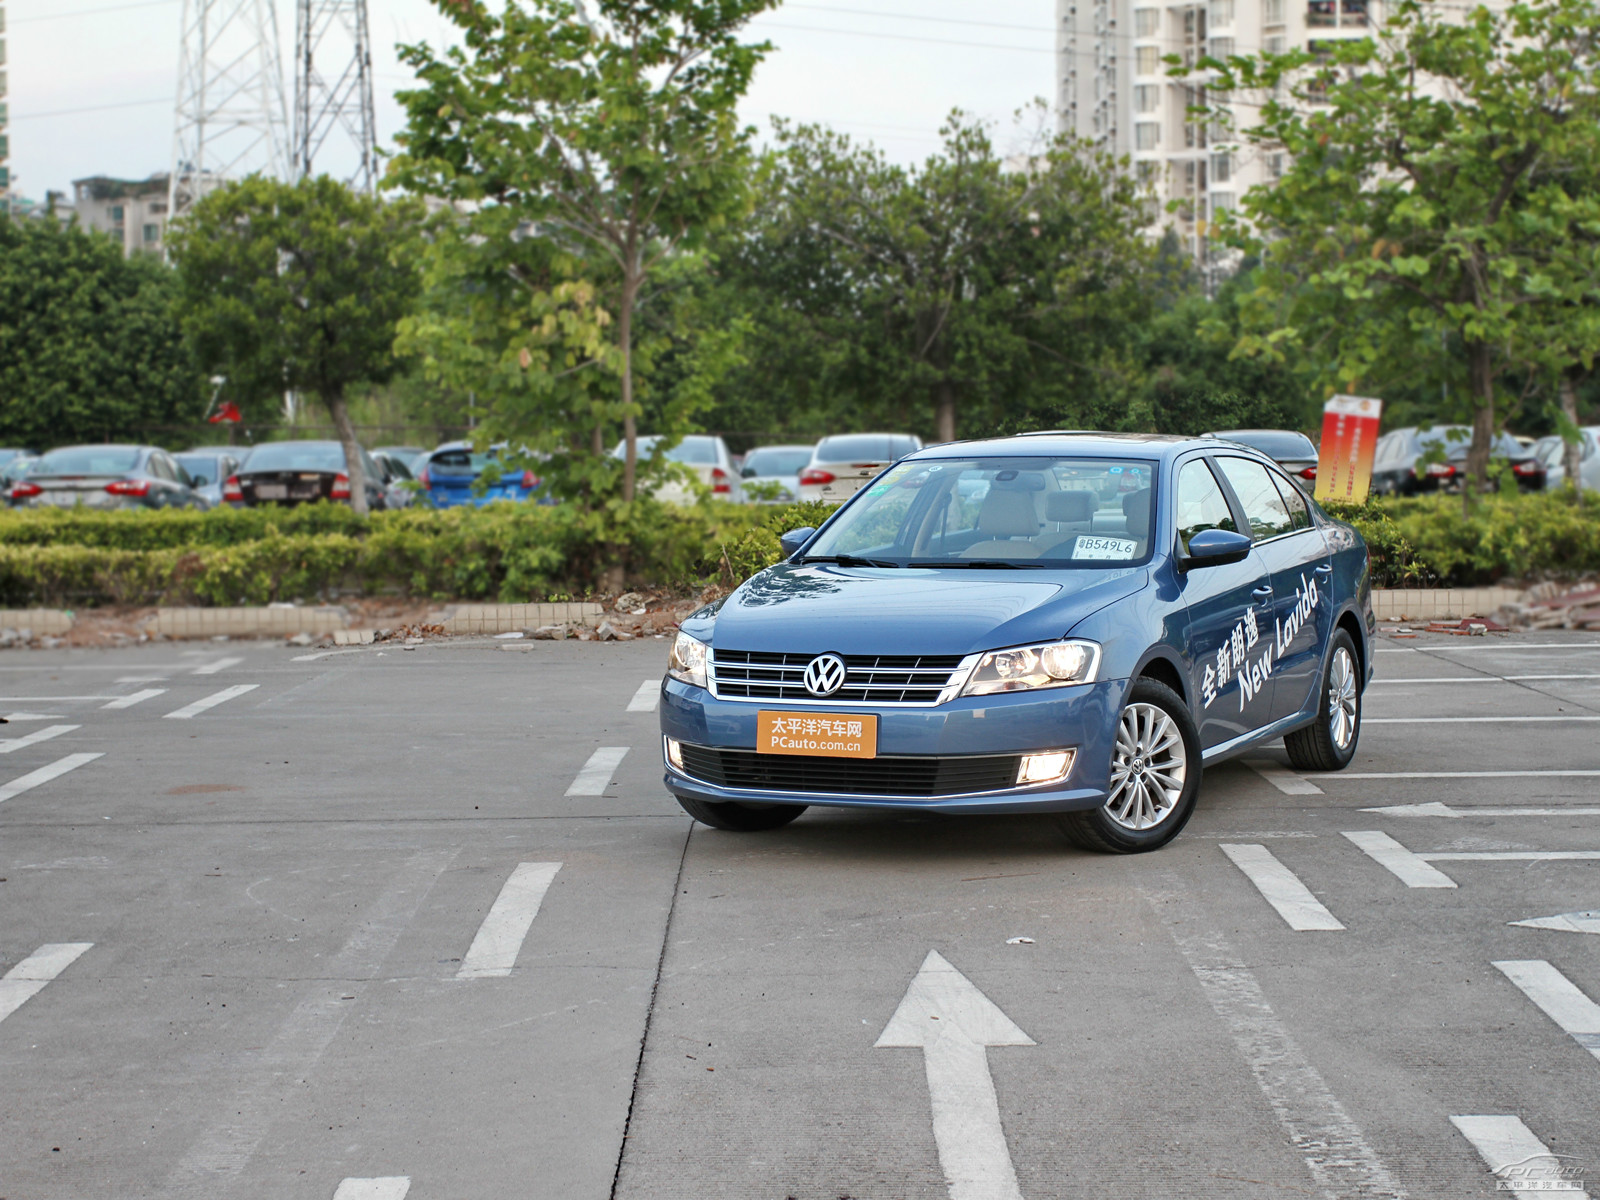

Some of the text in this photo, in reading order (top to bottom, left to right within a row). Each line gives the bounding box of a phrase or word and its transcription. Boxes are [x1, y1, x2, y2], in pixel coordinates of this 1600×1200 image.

[1202, 607, 1259, 709] 全新朗逸
[1238, 573, 1318, 712] New Lavida
[771, 717, 862, 738] 太平洋汽车网
[771, 736, 861, 752] PCauto.com.cn
